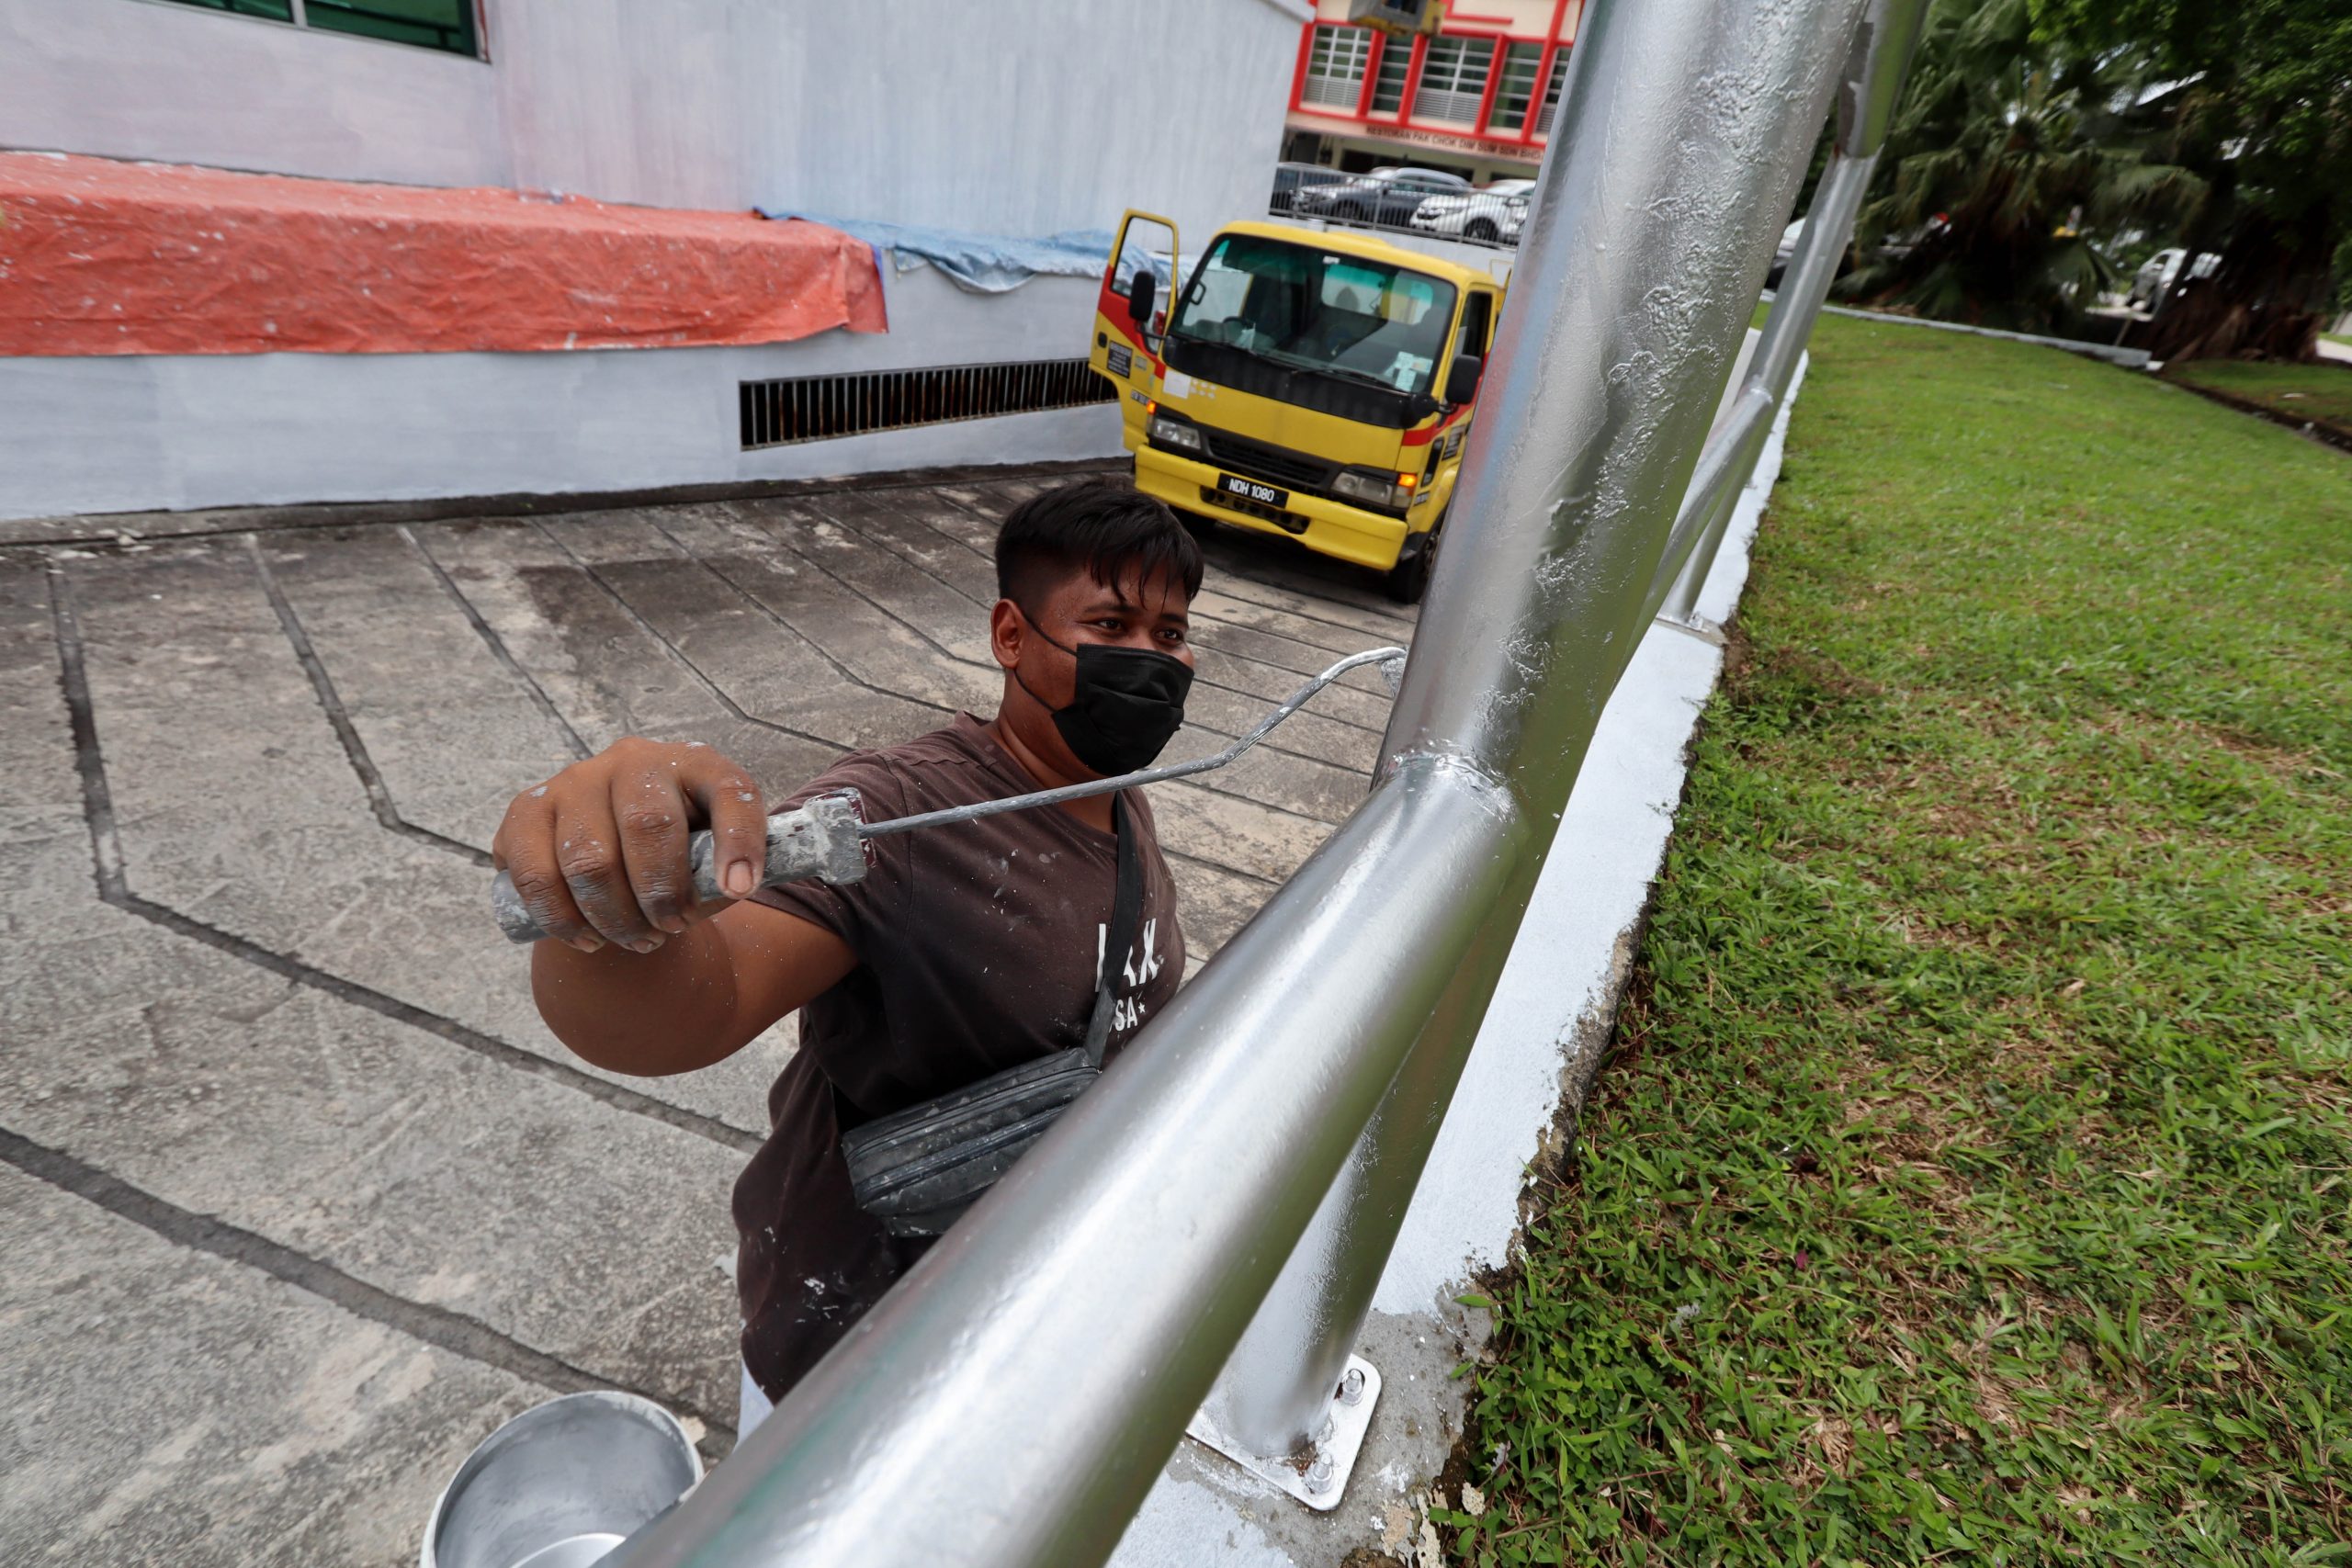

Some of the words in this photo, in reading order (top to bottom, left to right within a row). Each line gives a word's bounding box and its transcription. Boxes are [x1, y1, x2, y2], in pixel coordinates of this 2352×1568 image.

[1228, 478, 1250, 495] NDH
[1251, 485, 1274, 502] 1080
[1109, 996, 1138, 1032] SA
